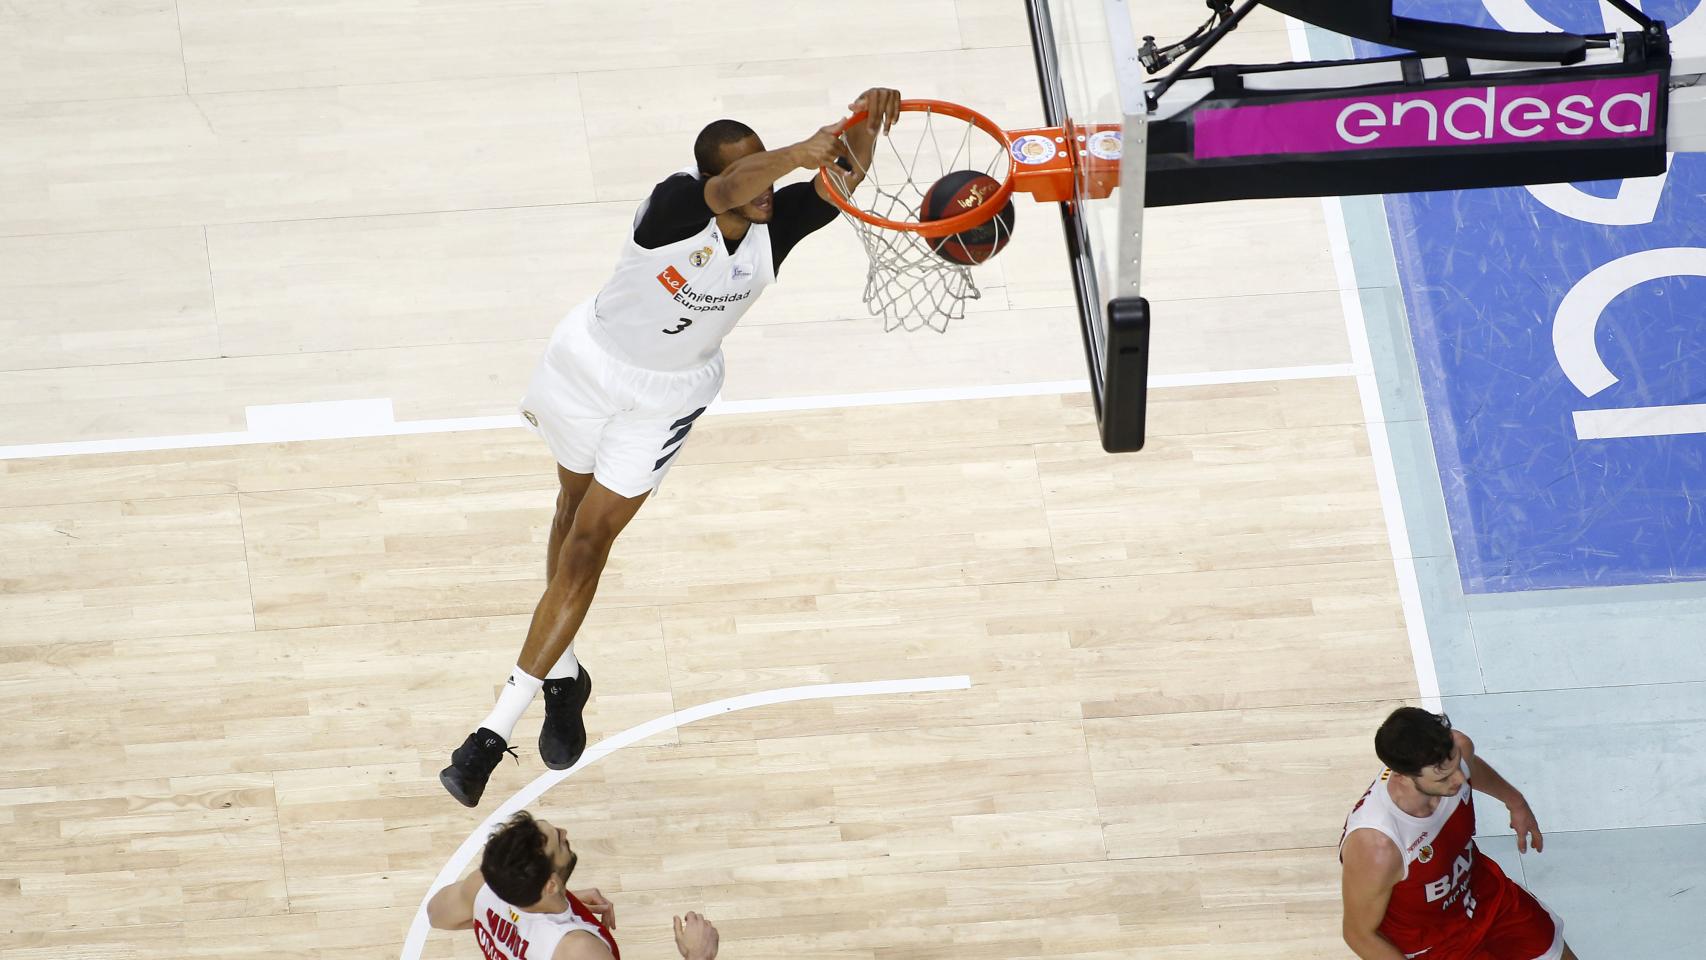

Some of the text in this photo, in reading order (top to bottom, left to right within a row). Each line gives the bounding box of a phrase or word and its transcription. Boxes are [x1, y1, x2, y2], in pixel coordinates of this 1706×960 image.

[1335, 86, 1651, 144] endesa
[673, 293, 726, 312] Europea
[681, 283, 751, 304] Universidad
[662, 317, 693, 335] 3
